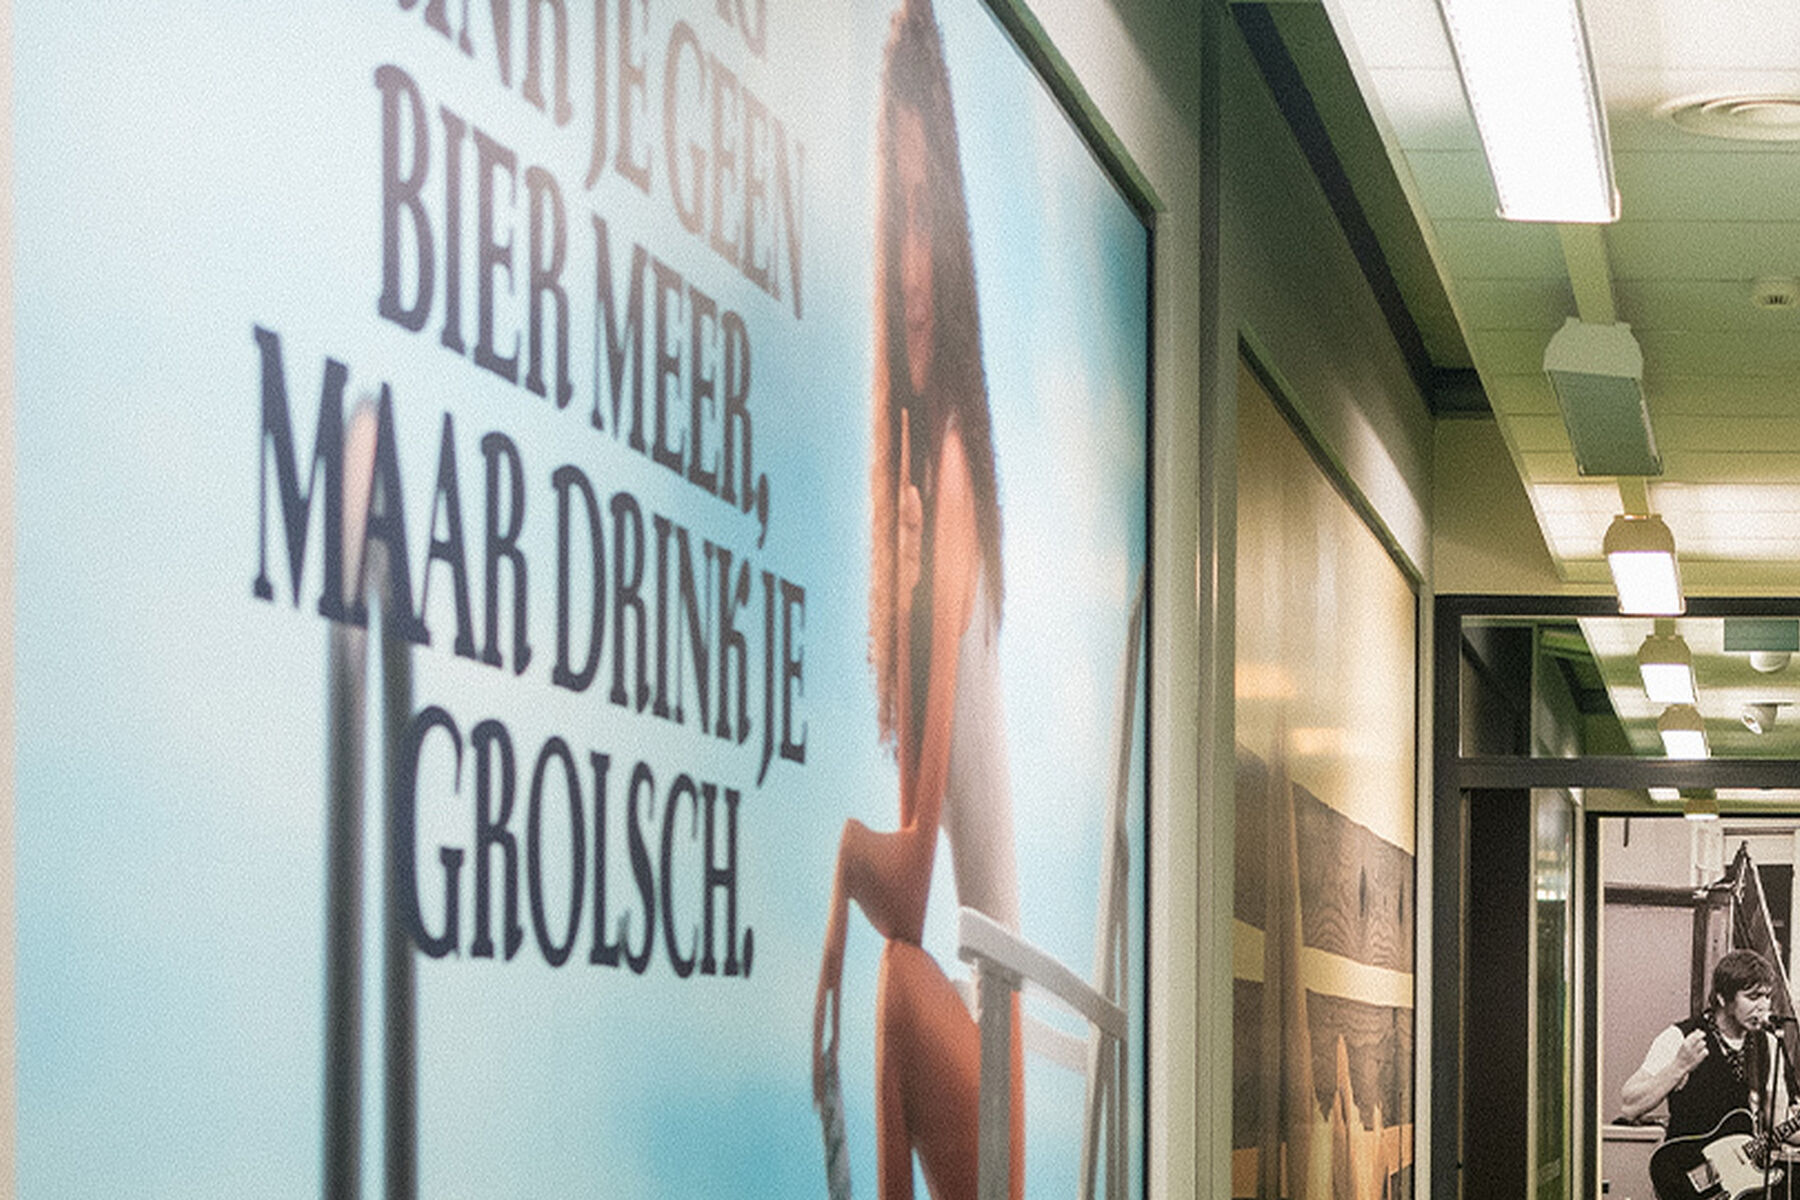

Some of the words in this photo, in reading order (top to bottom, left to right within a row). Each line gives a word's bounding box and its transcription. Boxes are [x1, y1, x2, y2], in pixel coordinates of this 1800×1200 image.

[373, 63, 574, 410] BIER
[591, 211, 770, 551] MEER,
[585, 0, 651, 195] JE
[662, 19, 805, 321] GEEN
[252, 323, 532, 676] MAAR
[551, 462, 751, 746] DRINK
[756, 566, 807, 788] JE
[402, 704, 755, 979] GROLSCH.
